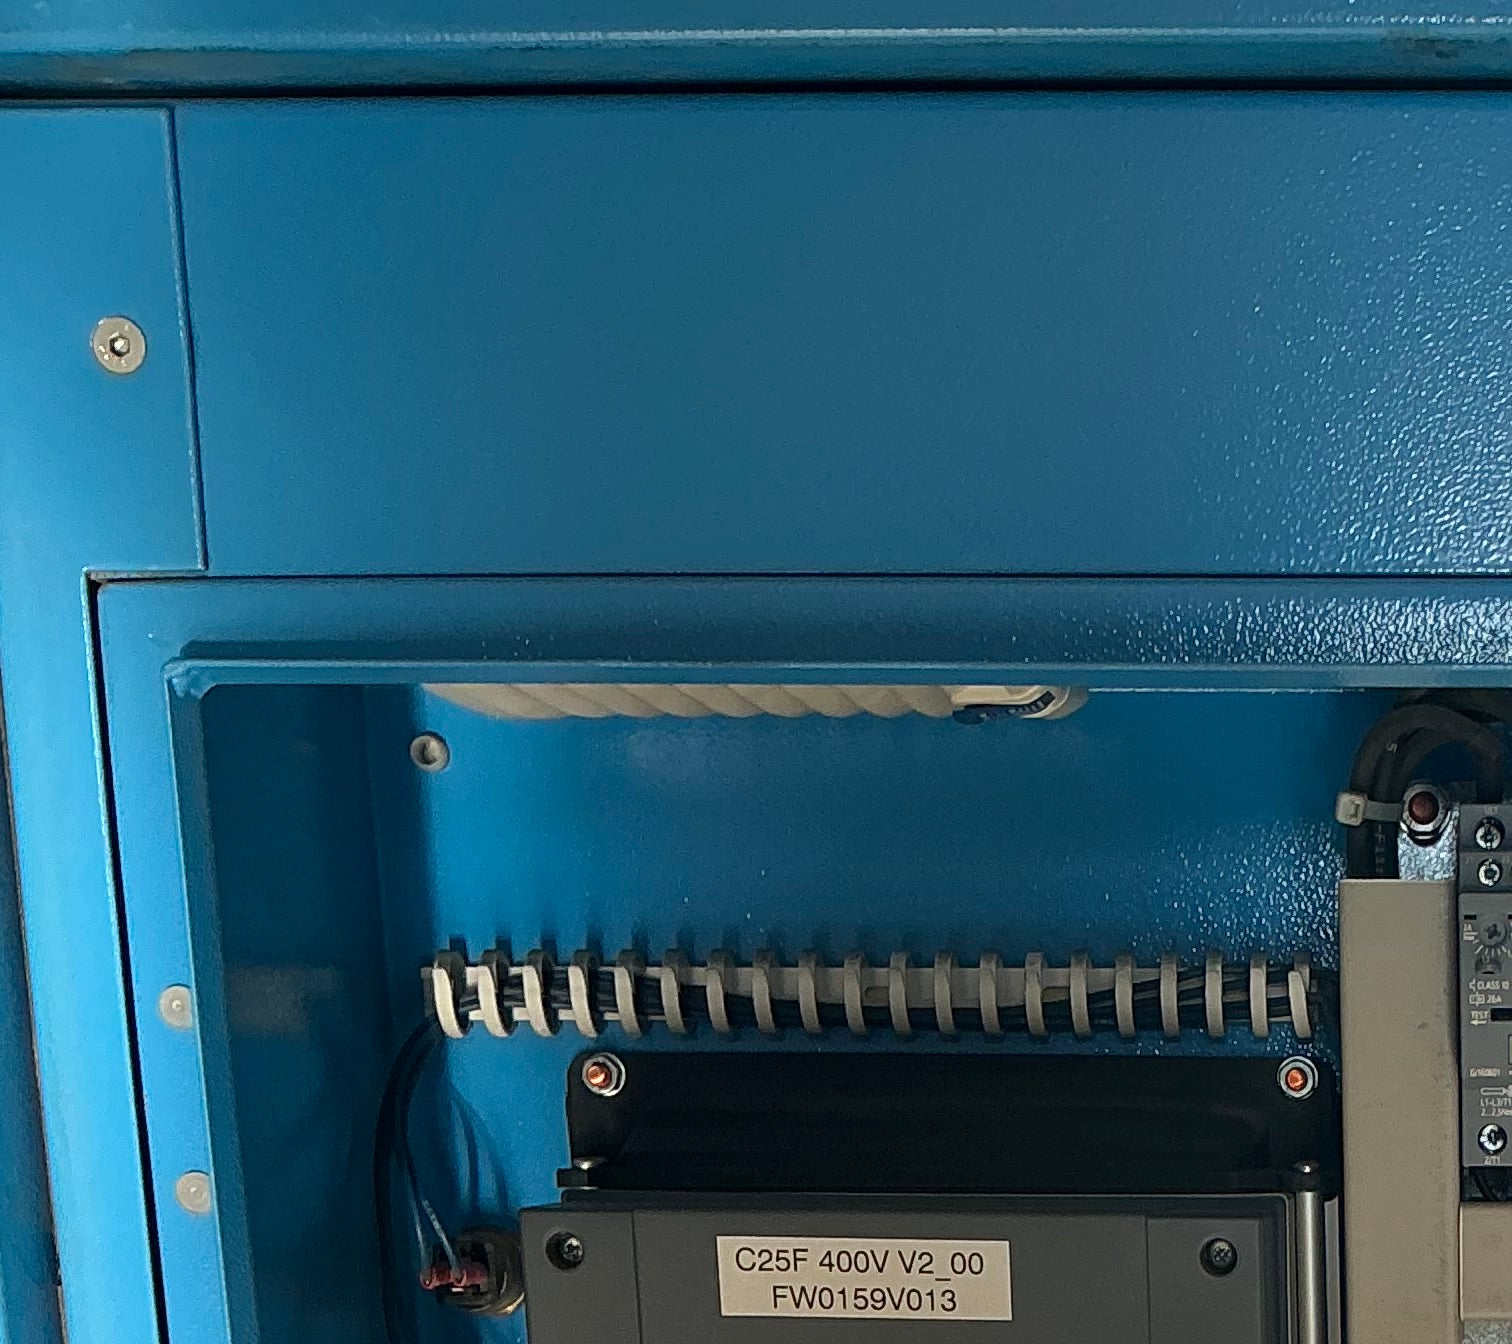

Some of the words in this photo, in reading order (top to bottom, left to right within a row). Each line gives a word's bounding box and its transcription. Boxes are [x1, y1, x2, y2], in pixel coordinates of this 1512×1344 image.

[735, 1247, 808, 1272] C25F
[819, 1250, 889, 1274] 400V
[898, 1249, 984, 1281] V2_00
[772, 1285, 957, 1312] FW0159V013
